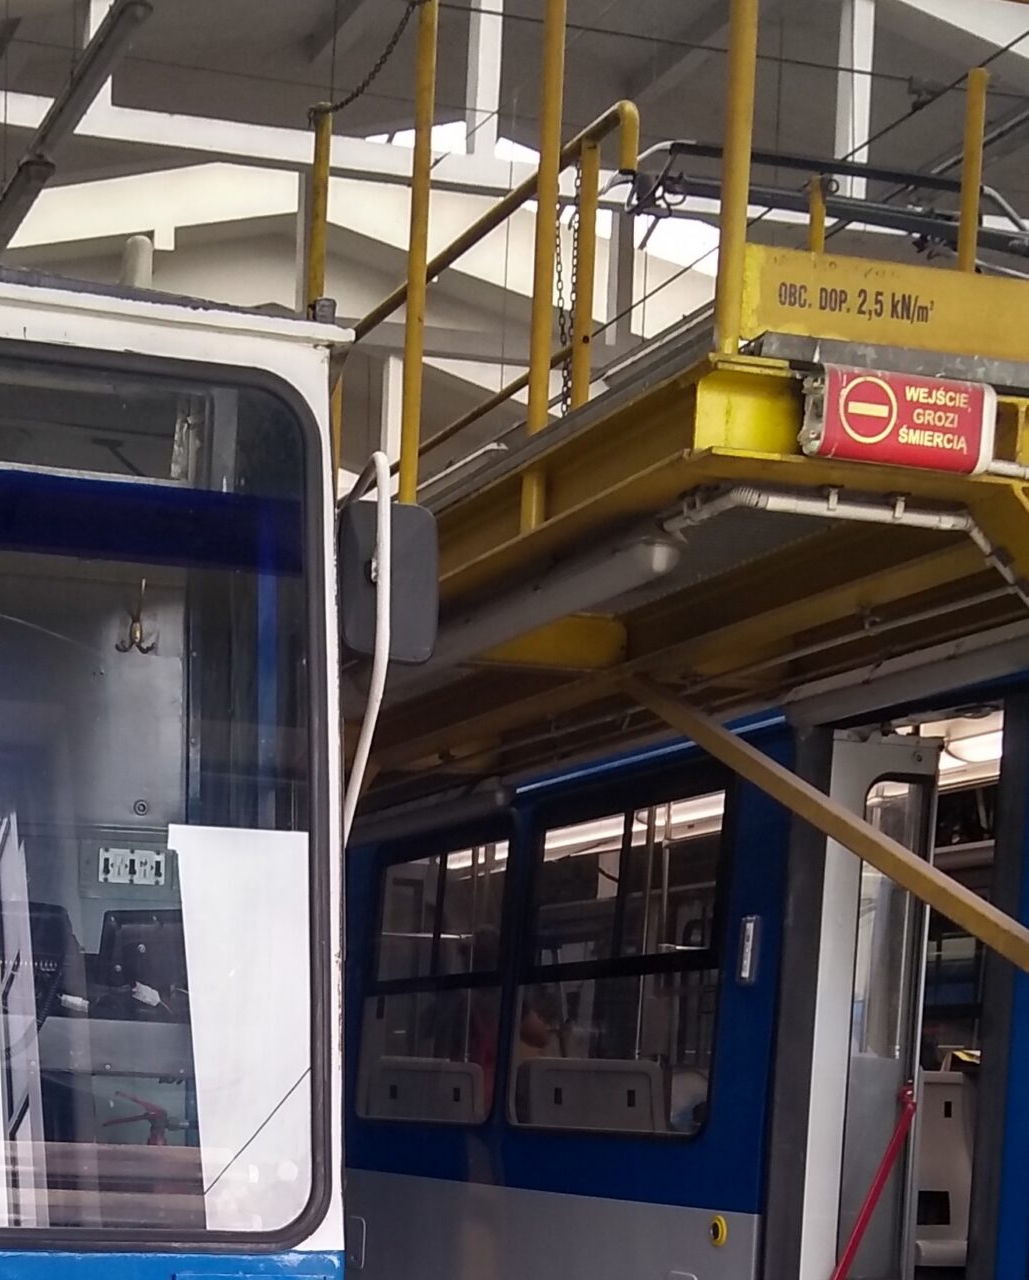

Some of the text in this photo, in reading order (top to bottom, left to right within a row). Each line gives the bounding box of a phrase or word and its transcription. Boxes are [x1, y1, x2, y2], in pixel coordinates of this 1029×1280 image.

[778, 281, 813, 309] OBC.
[818, 287, 851, 313] DOP.
[857, 288, 884, 321] 2,5
[913, 408, 959, 429] GROZI
[897, 424, 968, 455] ŚMIERCIĄ
